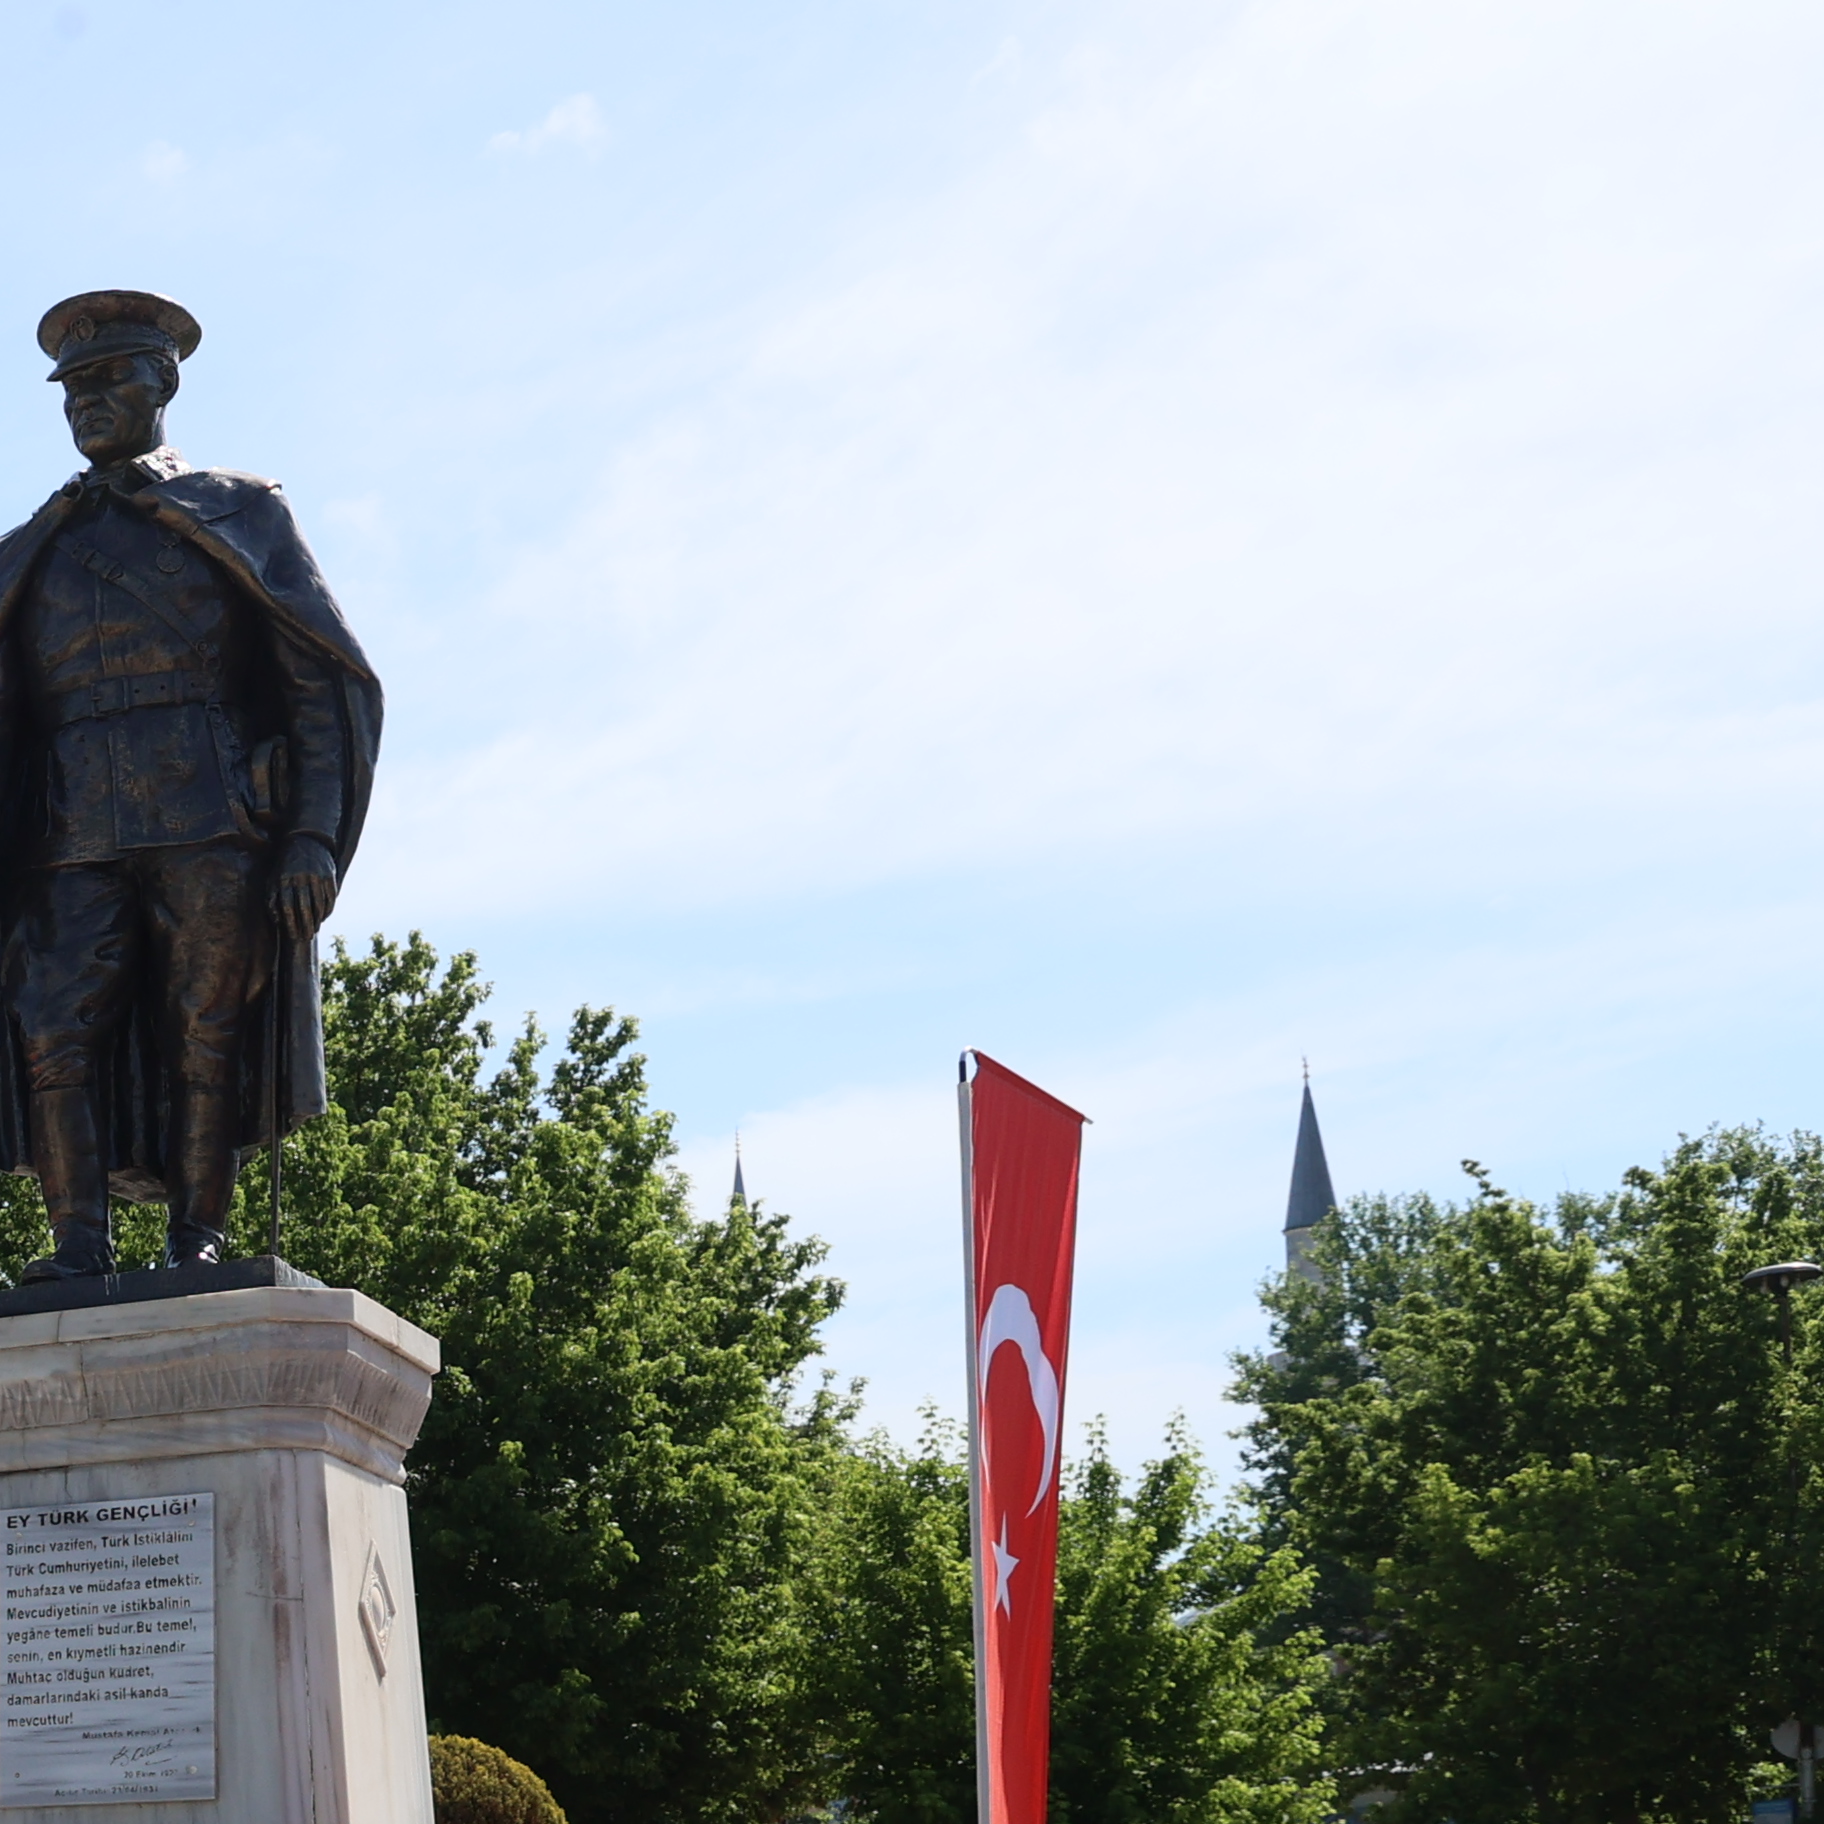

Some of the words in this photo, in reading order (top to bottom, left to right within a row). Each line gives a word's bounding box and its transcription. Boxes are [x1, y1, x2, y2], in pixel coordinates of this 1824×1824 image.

[6, 1514, 31, 1529] EY
[37, 1509, 89, 1526] TÜRK
[6, 1563, 34, 1578] Türk
[38, 1556, 129, 1576] Cumhuriyetini,
[132, 1552, 180, 1568] ilelebet
[6, 1582, 65, 1600] muhafaza
[69, 1583, 83, 1595] ve
[87, 1577, 141, 1593] müdafaa
[145, 1573, 203, 1590] etmektir.
[6, 1602, 99, 1621] Mevcudiyetinin
[103, 1603, 117, 1614] ve
[121, 1596, 191, 1613] istikbalinin
[47, 1649, 62, 1661] en
[130, 1685, 169, 1700] kanda
[7, 1712, 74, 1728] mevcuttur!
